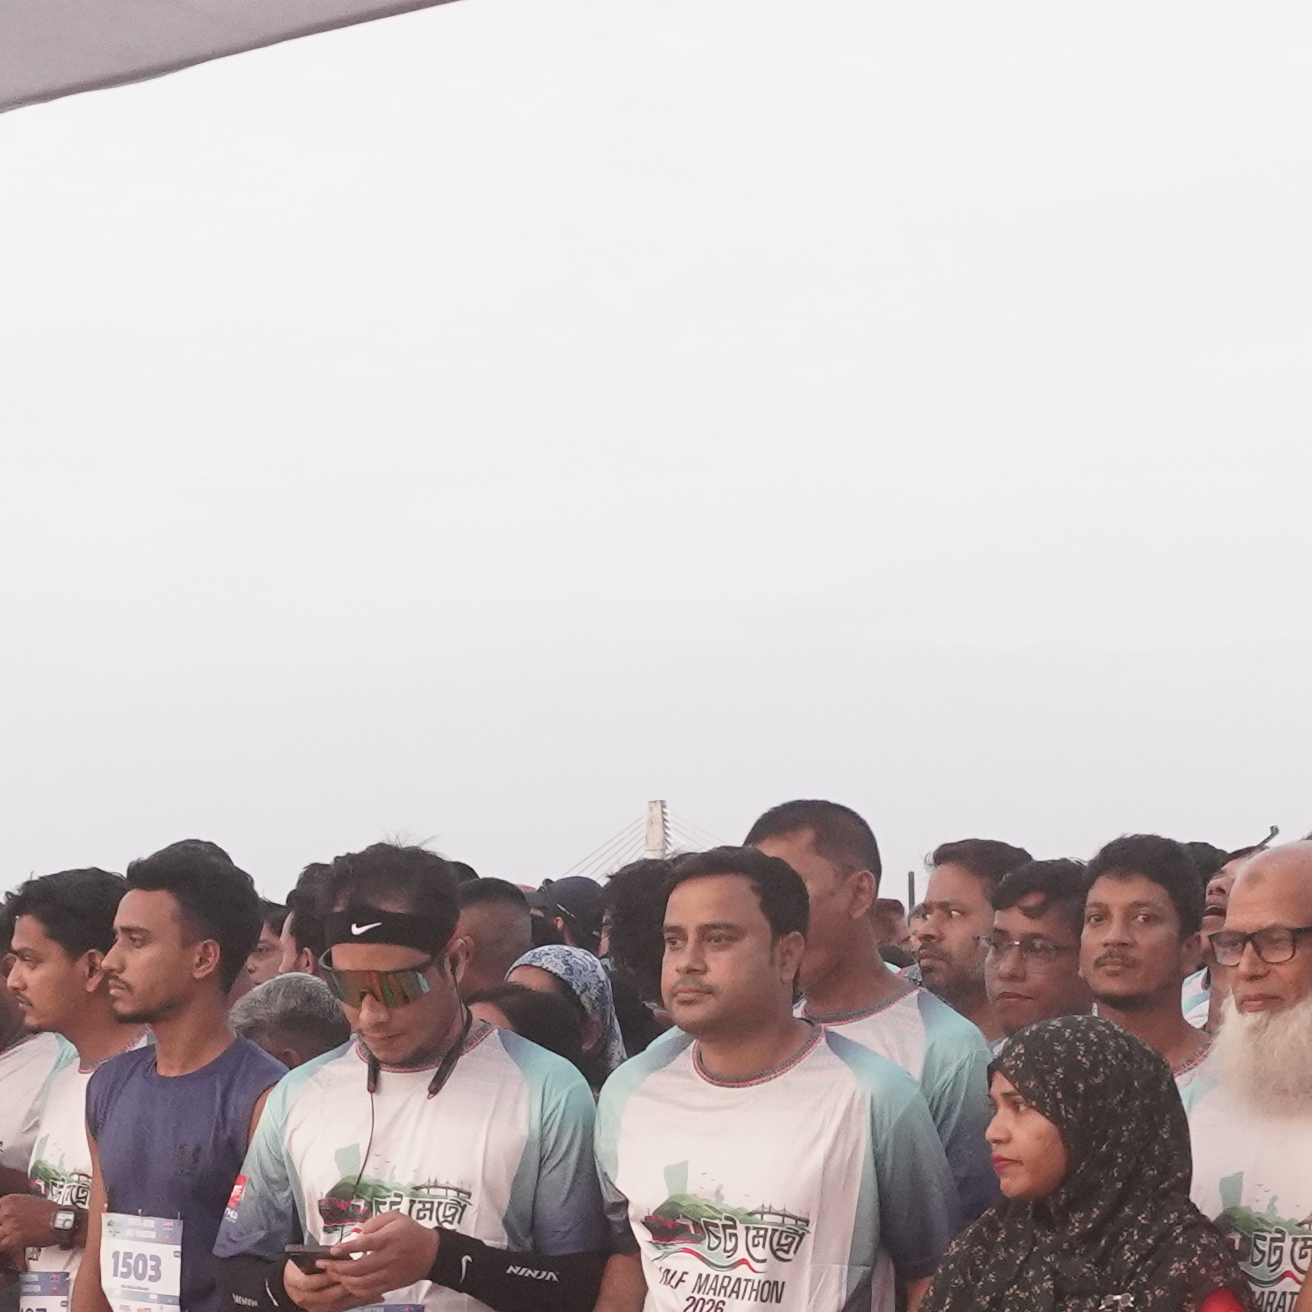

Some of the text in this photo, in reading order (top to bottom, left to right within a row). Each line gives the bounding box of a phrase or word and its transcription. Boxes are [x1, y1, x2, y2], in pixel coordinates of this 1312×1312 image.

[111, 1249, 163, 1283] 1503
[505, 1264, 560, 1283] NINJA
[691, 1272, 786, 1304] MARATHON
